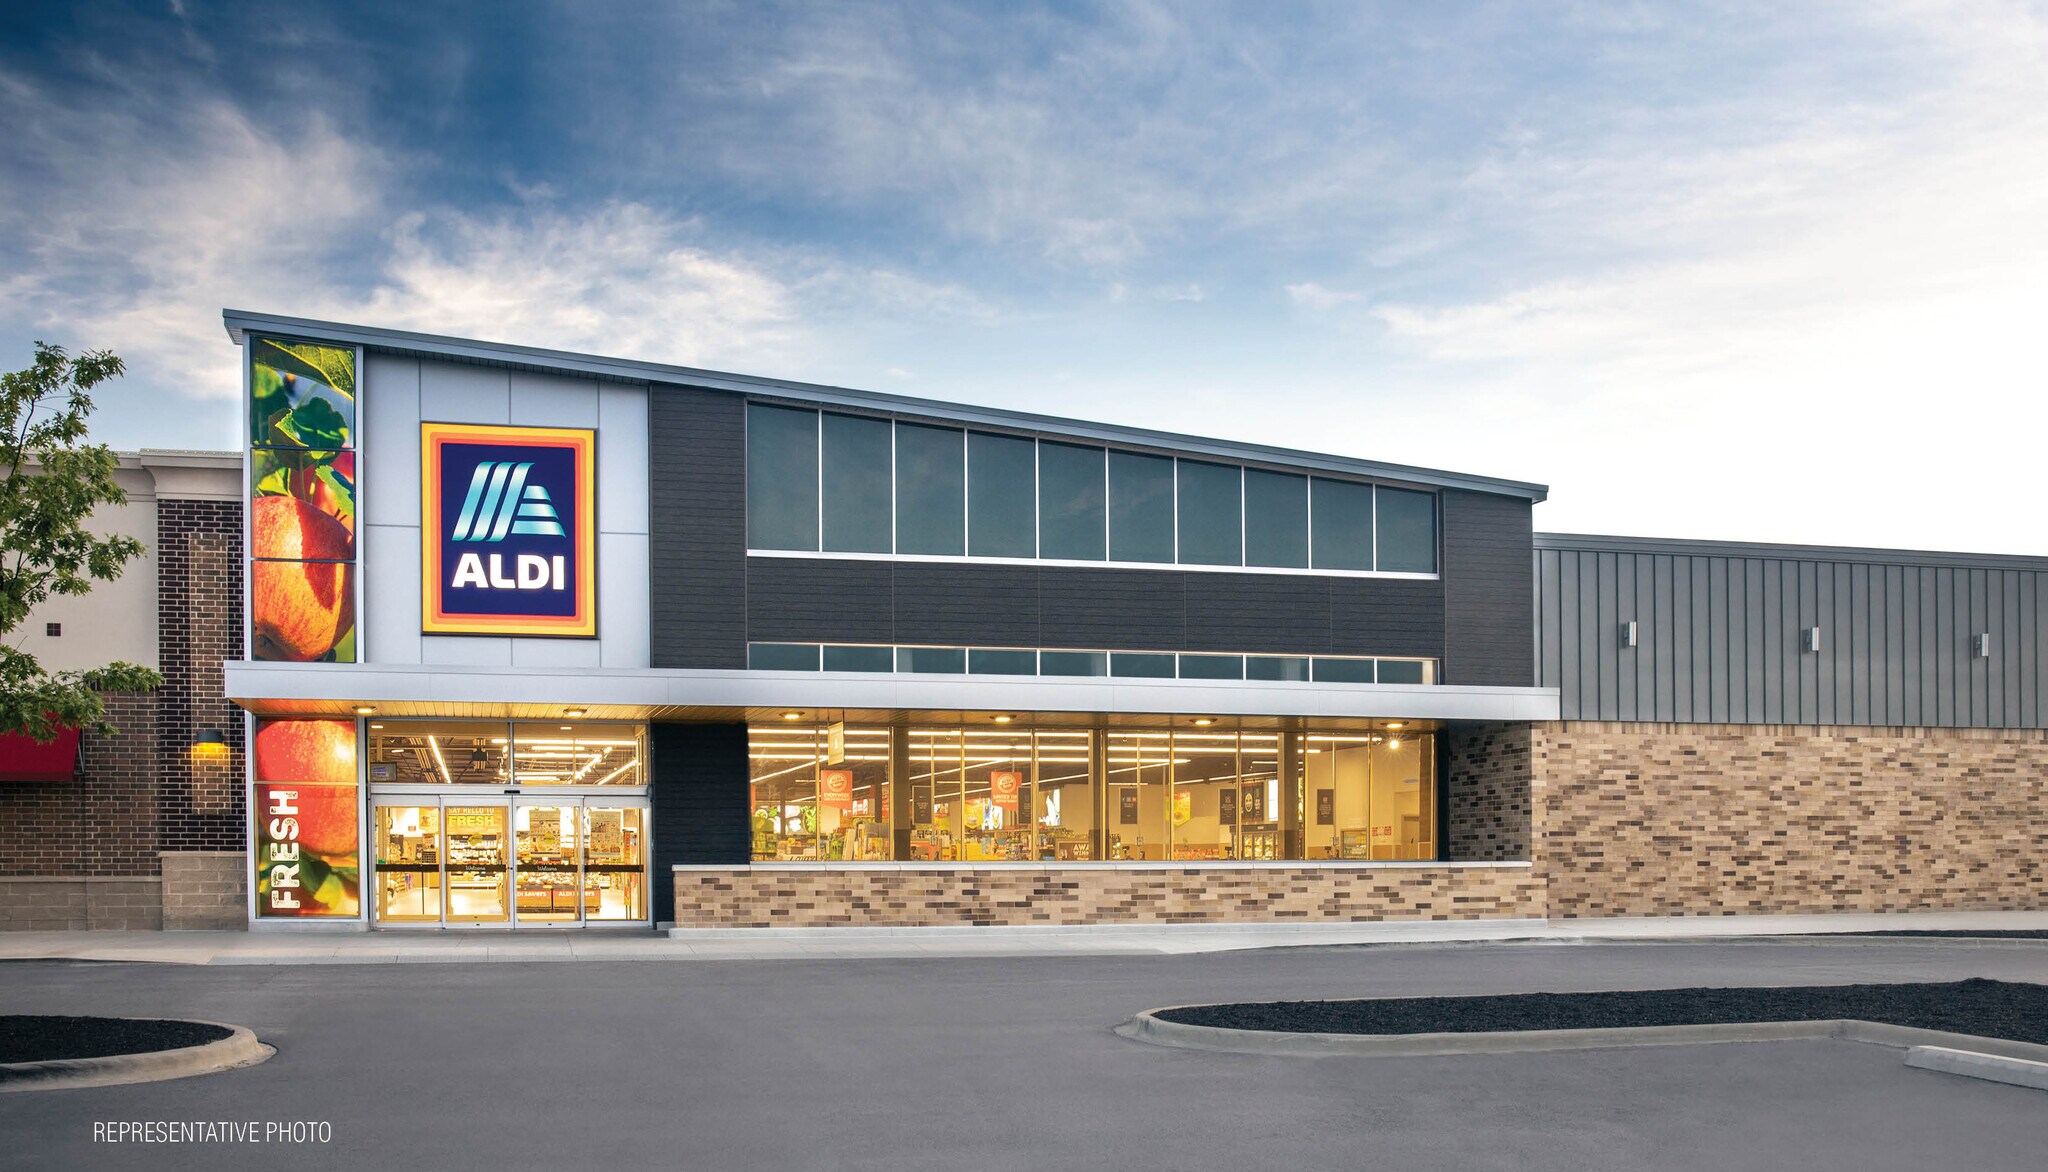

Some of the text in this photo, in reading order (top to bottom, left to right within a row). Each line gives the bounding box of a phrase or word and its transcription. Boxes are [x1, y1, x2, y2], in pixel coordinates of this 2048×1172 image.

[452, 554, 565, 590] ALDI
[448, 815, 495, 826] FRESH
[269, 790, 301, 909] FRESH
